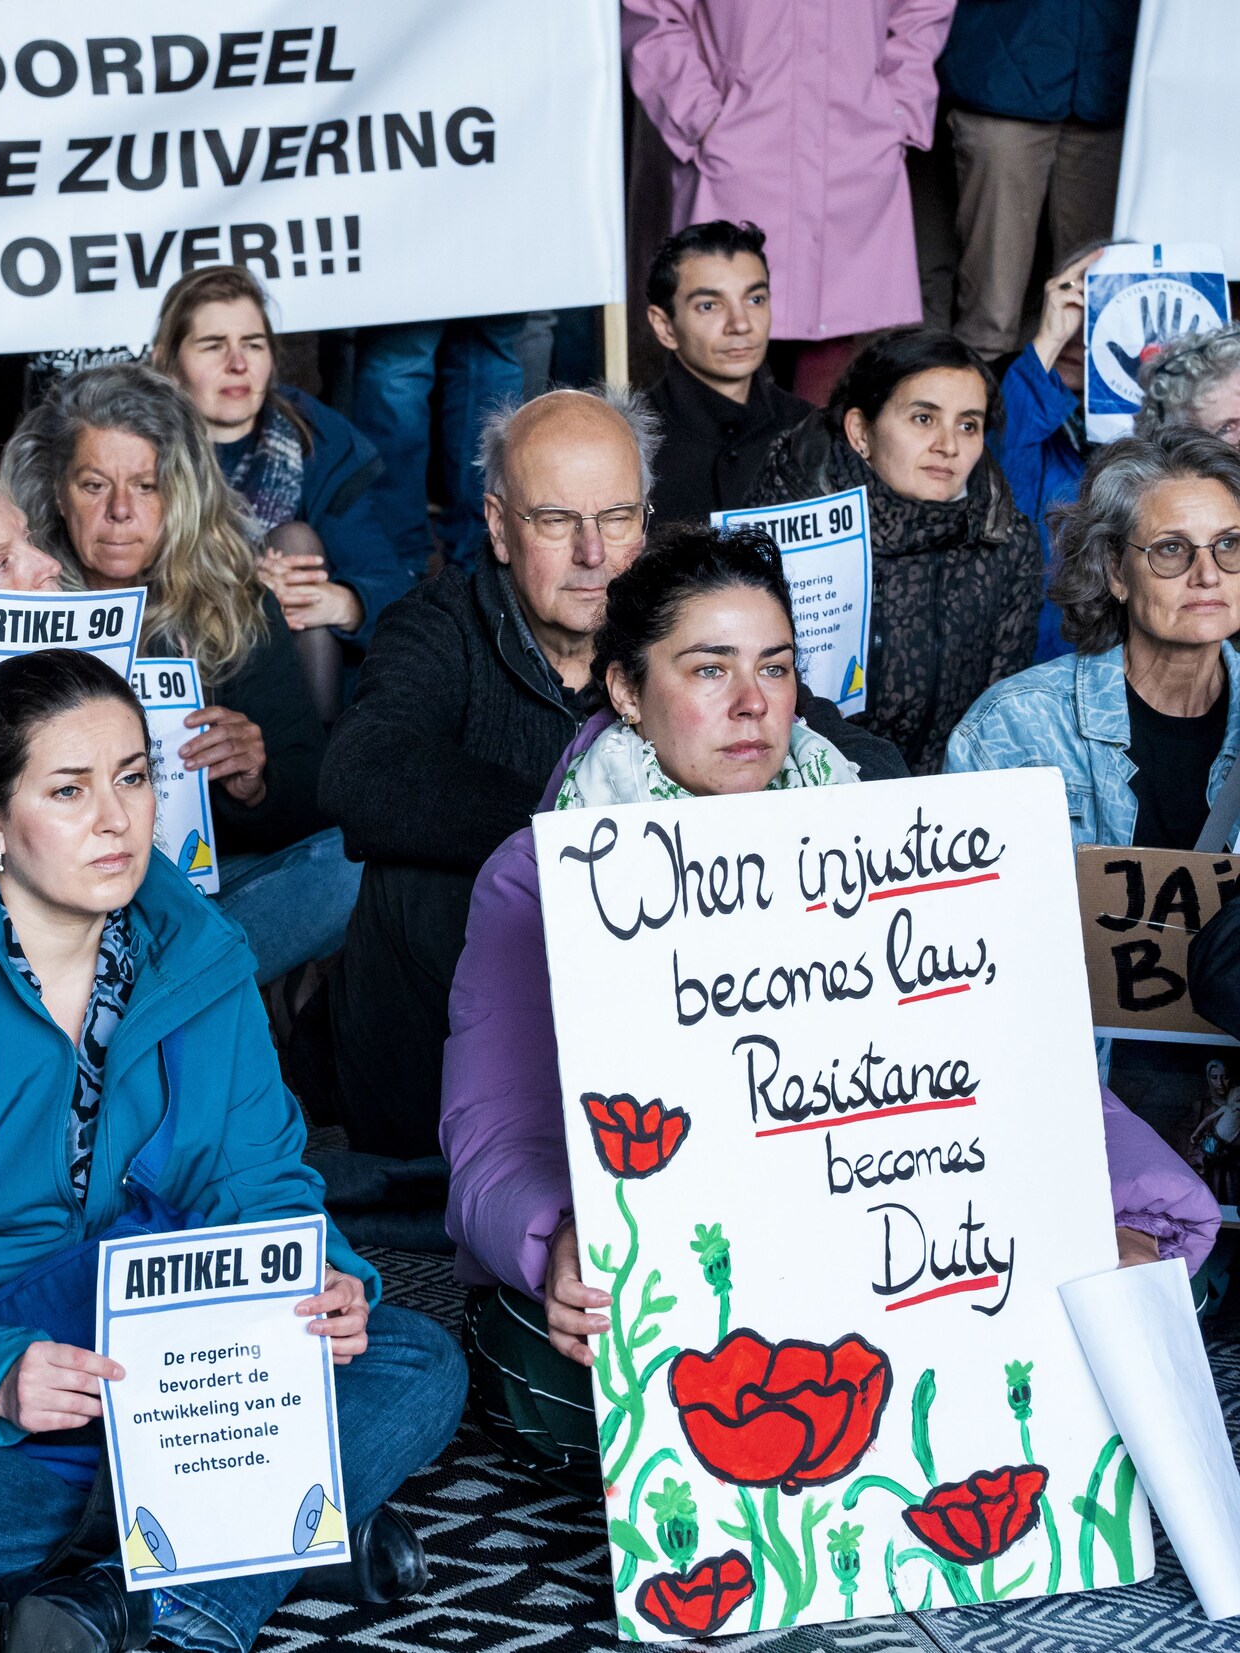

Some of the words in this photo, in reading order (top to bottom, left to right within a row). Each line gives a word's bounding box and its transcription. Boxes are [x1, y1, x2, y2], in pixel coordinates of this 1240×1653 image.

[58, 106, 496, 194] ZUIVERING
[741, 512, 822, 544] TIKEL
[829, 504, 853, 534] 90
[793, 593, 822, 605] rdert
[824, 590, 837, 600] de
[822, 607, 840, 617] van
[842, 602, 853, 612] de
[88, 606, 124, 640] 90
[159, 671, 186, 699] 90
[170, 771, 184, 781] de
[560, 817, 773, 940] When
[798, 806, 1006, 919] injustice
[673, 949, 874, 1026] becomes
[885, 907, 997, 996] law,
[731, 1034, 981, 1123] Resistance
[826, 1130, 986, 1195] becomes
[125, 1247, 249, 1300] ARTIKEL
[261, 1241, 302, 1284] 90
[866, 1200, 1015, 1317] Duty
[164, 1351, 185, 1367] De
[190, 1342, 262, 1364] regering
[159, 1372, 244, 1393] bevordert
[248, 1368, 269, 1384] de
[133, 1399, 240, 1425] ontwikkeling
[244, 1396, 276, 1411] van
[280, 1392, 302, 1407] de
[159, 1422, 279, 1449] internationale
[173, 1451, 270, 1475] rechtsorde.
